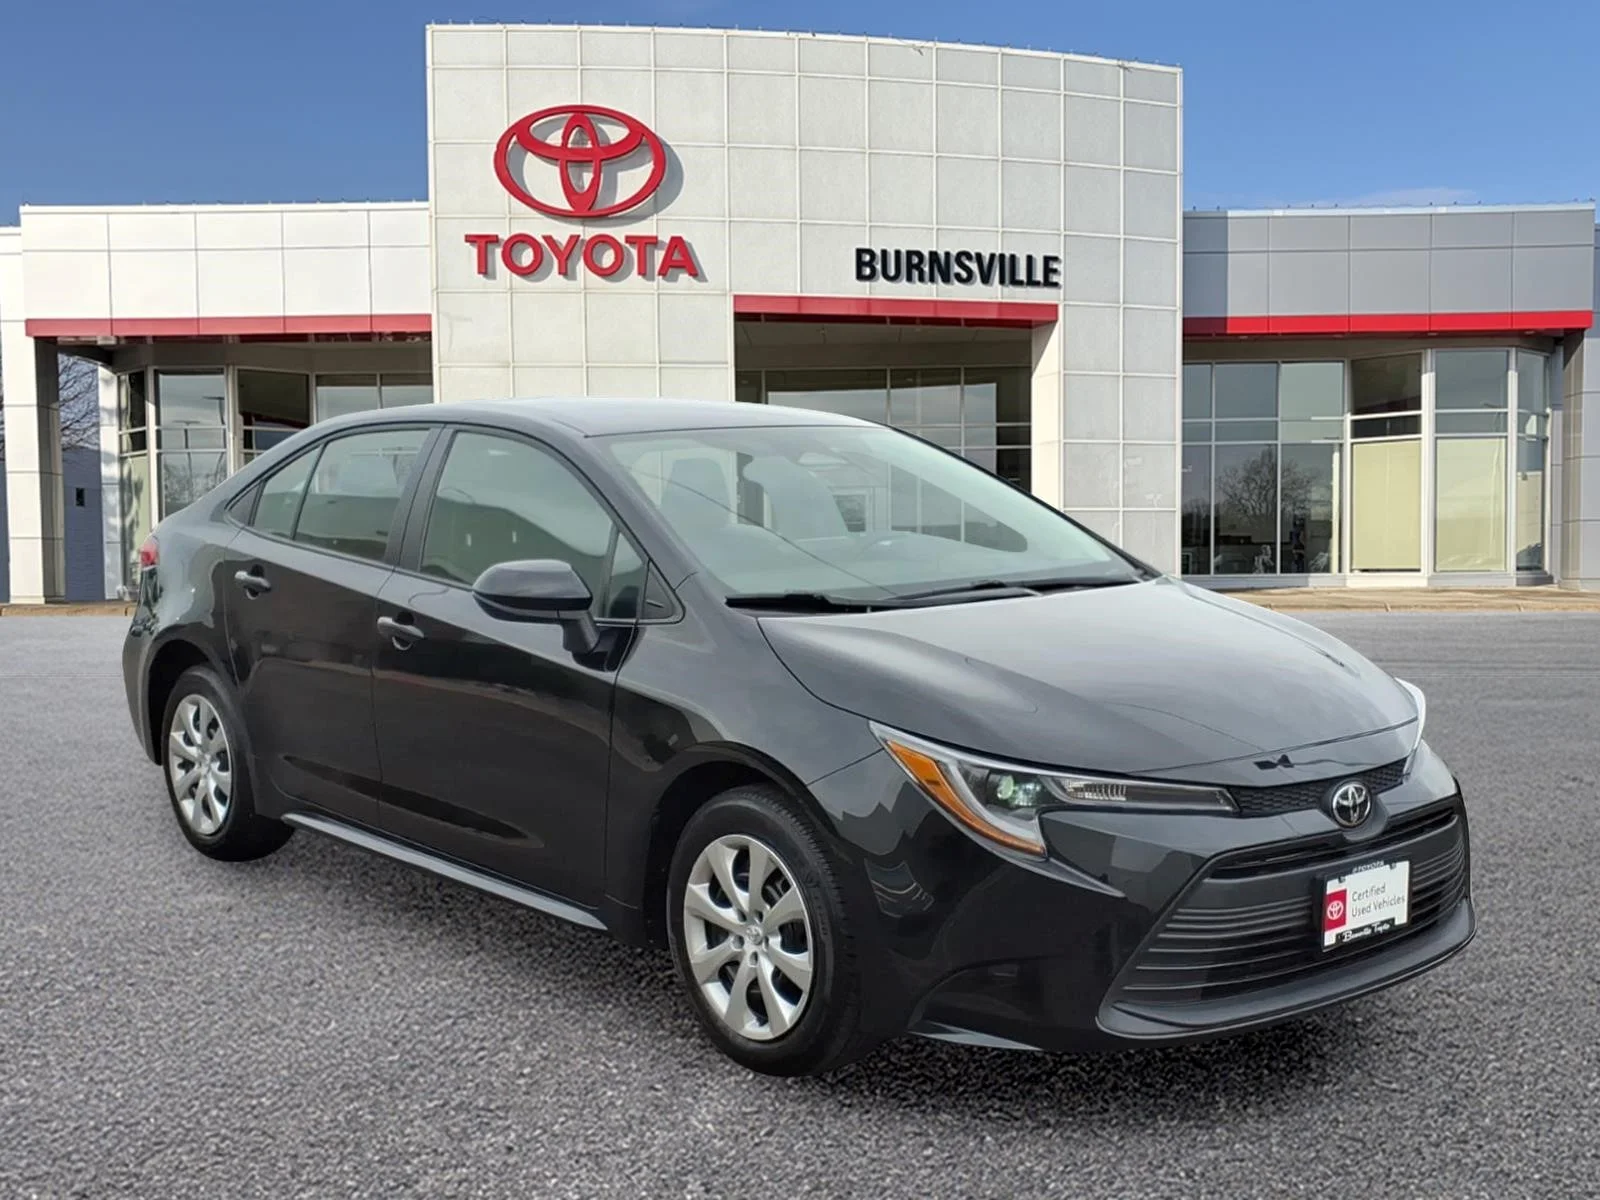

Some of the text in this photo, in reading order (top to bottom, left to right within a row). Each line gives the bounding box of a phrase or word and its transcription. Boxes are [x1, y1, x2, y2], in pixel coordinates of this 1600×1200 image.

[464, 233, 698, 276] TOYOTA
[855, 248, 1061, 287] BURNSVILLE
[1351, 883, 1386, 902] Certified
[1351, 895, 1405, 918] Used Vehicles
